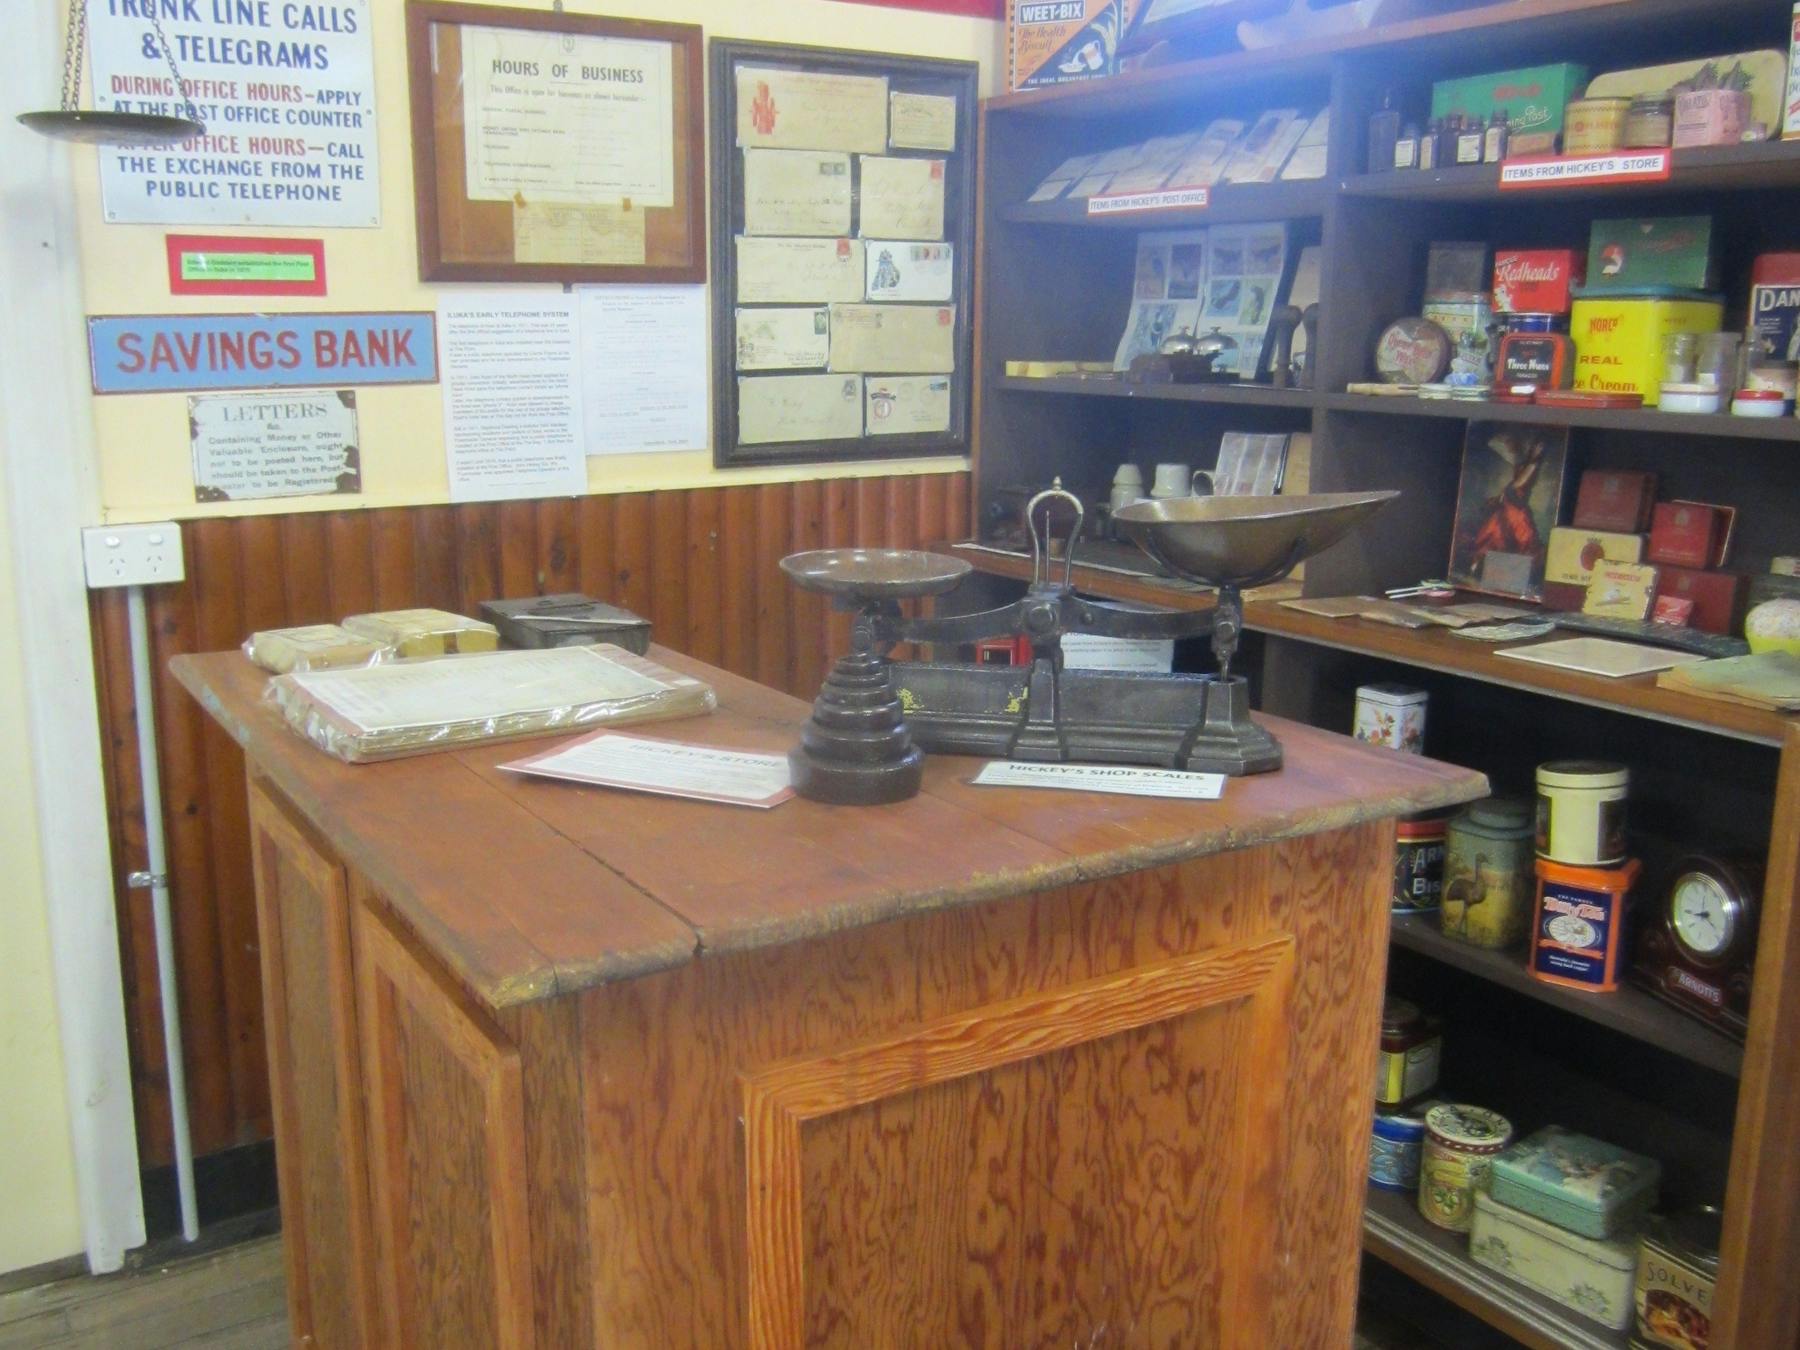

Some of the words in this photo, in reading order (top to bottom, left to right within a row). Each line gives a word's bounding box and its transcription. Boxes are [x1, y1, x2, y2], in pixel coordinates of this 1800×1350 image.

[106, 0, 202, 22] TRUNK
[212, 0, 272, 27] LINE
[282, 3, 358, 34] CALLS
[1022, 2, 1082, 22] WEET-BIX
[141, 32, 162, 60] &
[175, 34, 329, 70] TELEGRAMS
[492, 59, 540, 77] HOURS
[552, 63, 569, 79] OF
[581, 65, 644, 84] BUSINESS
[110, 75, 174, 97] DURING
[181, 79, 238, 100] OFFICE
[113, 100, 132, 113] AT
[137, 101, 169, 117] THE
[174, 103, 218, 121] POST
[224, 105, 280, 125] OFFICE
[286, 108, 362, 128] COUNTER
[181, 135, 240, 154] OFFICE
[117, 156, 157, 174] THE
[165, 158, 263, 177] EXCHANGE
[271, 161, 321, 179] FROM
[329, 163, 364, 181] THE
[1504, 168, 1534, 180] ITEMS
[1536, 165, 1564, 177] FROM
[1566, 161, 1615, 175] HICKEY'S
[1622, 157, 1660, 171] STORE
[146, 180, 220, 198] PUBLIC
[228, 182, 342, 202] TELEPHONE
[1090, 200, 1110, 210] ITEMS
[1111, 199, 1130, 209] FROM
[1162, 195, 1180, 205] POST
[1181, 193, 1206, 204] OFFICE
[1500, 262, 1560, 285] Redheads
[476, 311, 499, 319] EARLY
[501, 311, 541, 319] TELEPHONE
[116, 330, 302, 374] SAVINGS
[313, 327, 417, 369] BANK
[1580, 355, 1623, 365] REAL
[1507, 358, 1528, 370] Three
[1590, 373, 1639, 392] Cream
[223, 403, 328, 422] LETTERS
[208, 436, 262, 446] Containing
[267, 434, 297, 443] Money
[316, 431, 342, 439] Other
[265, 456, 296, 467] posted
[260, 468, 287, 476] taken
[1009, 763, 1084, 775] HICKEY'S
[1089, 768, 1138, 777] SHOP
[1142, 770, 1206, 781] SCALES
